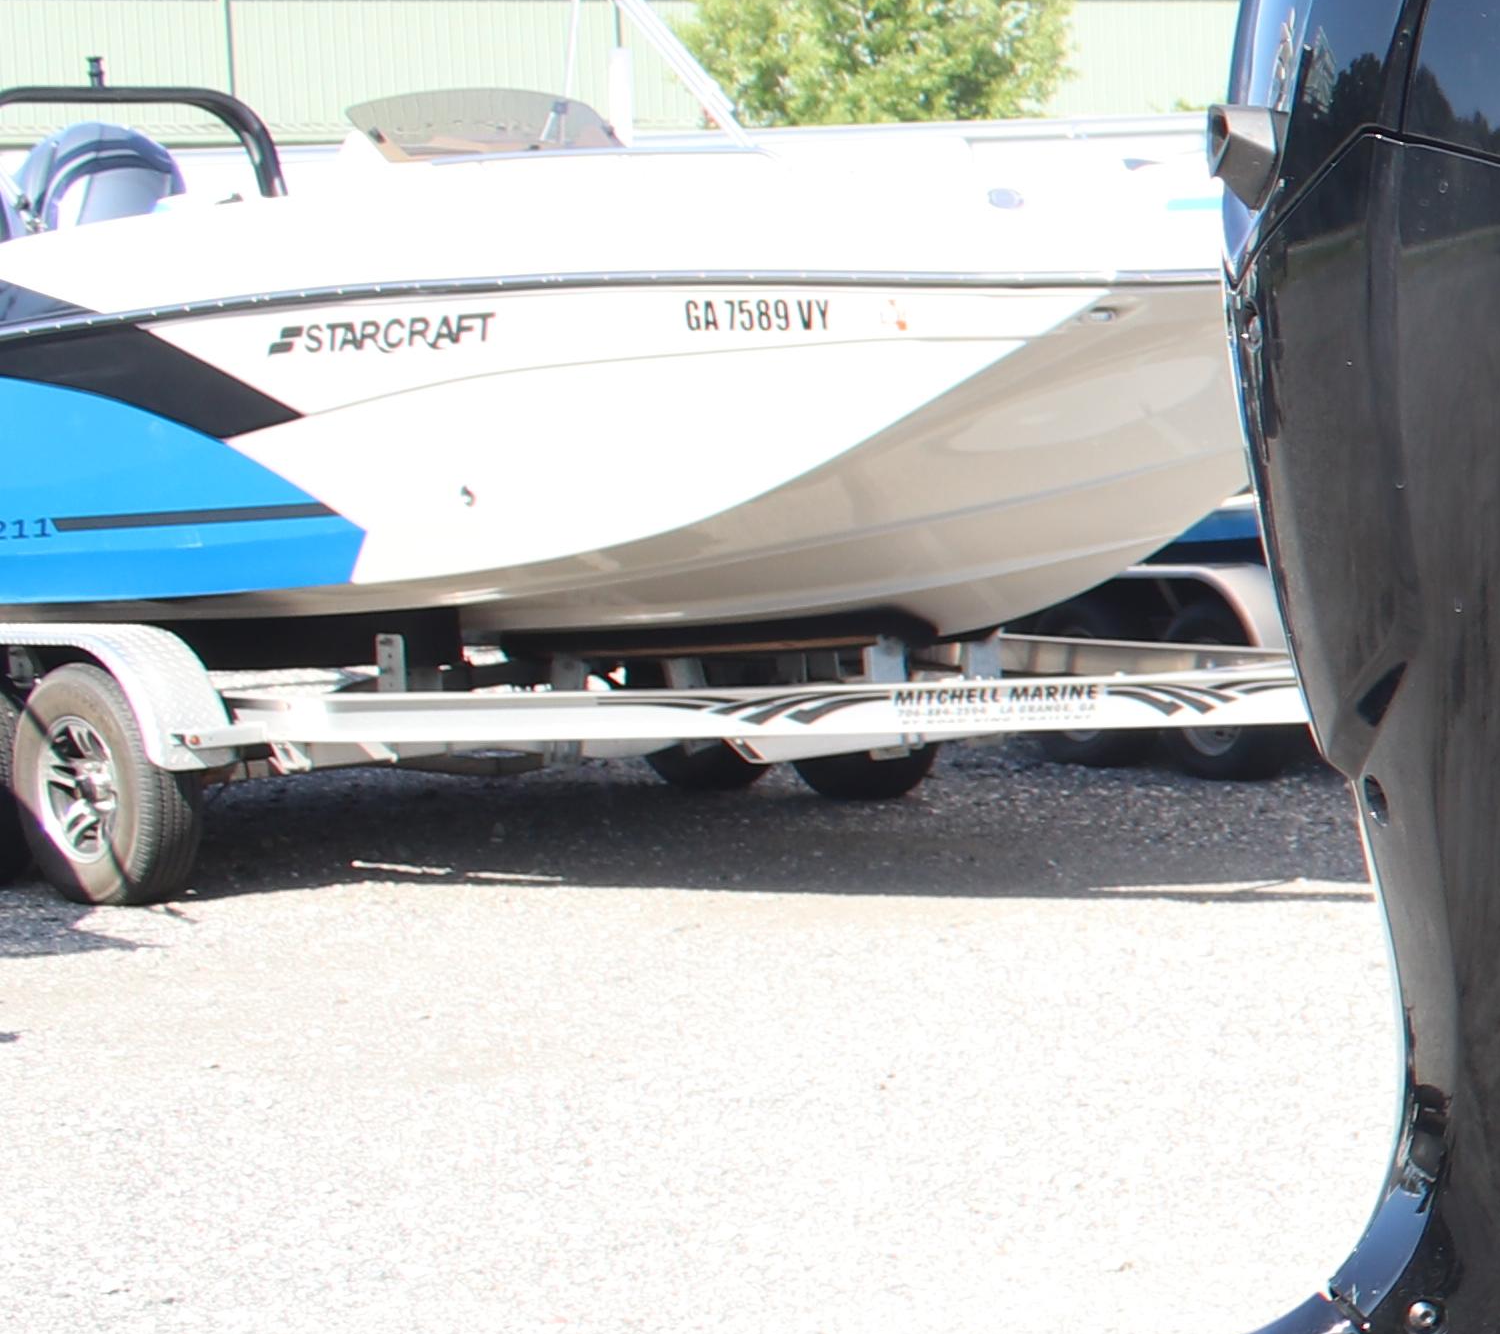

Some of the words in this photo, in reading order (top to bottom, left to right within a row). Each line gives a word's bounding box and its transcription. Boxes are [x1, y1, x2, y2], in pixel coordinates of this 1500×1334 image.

[684, 299, 719, 332] GA
[724, 299, 790, 332] 7589
[796, 299, 829, 331] VY
[304, 312, 495, 355] STARCRAFT
[894, 687, 1001, 706] MITCHELL
[1009, 683, 1099, 702] MARINE
